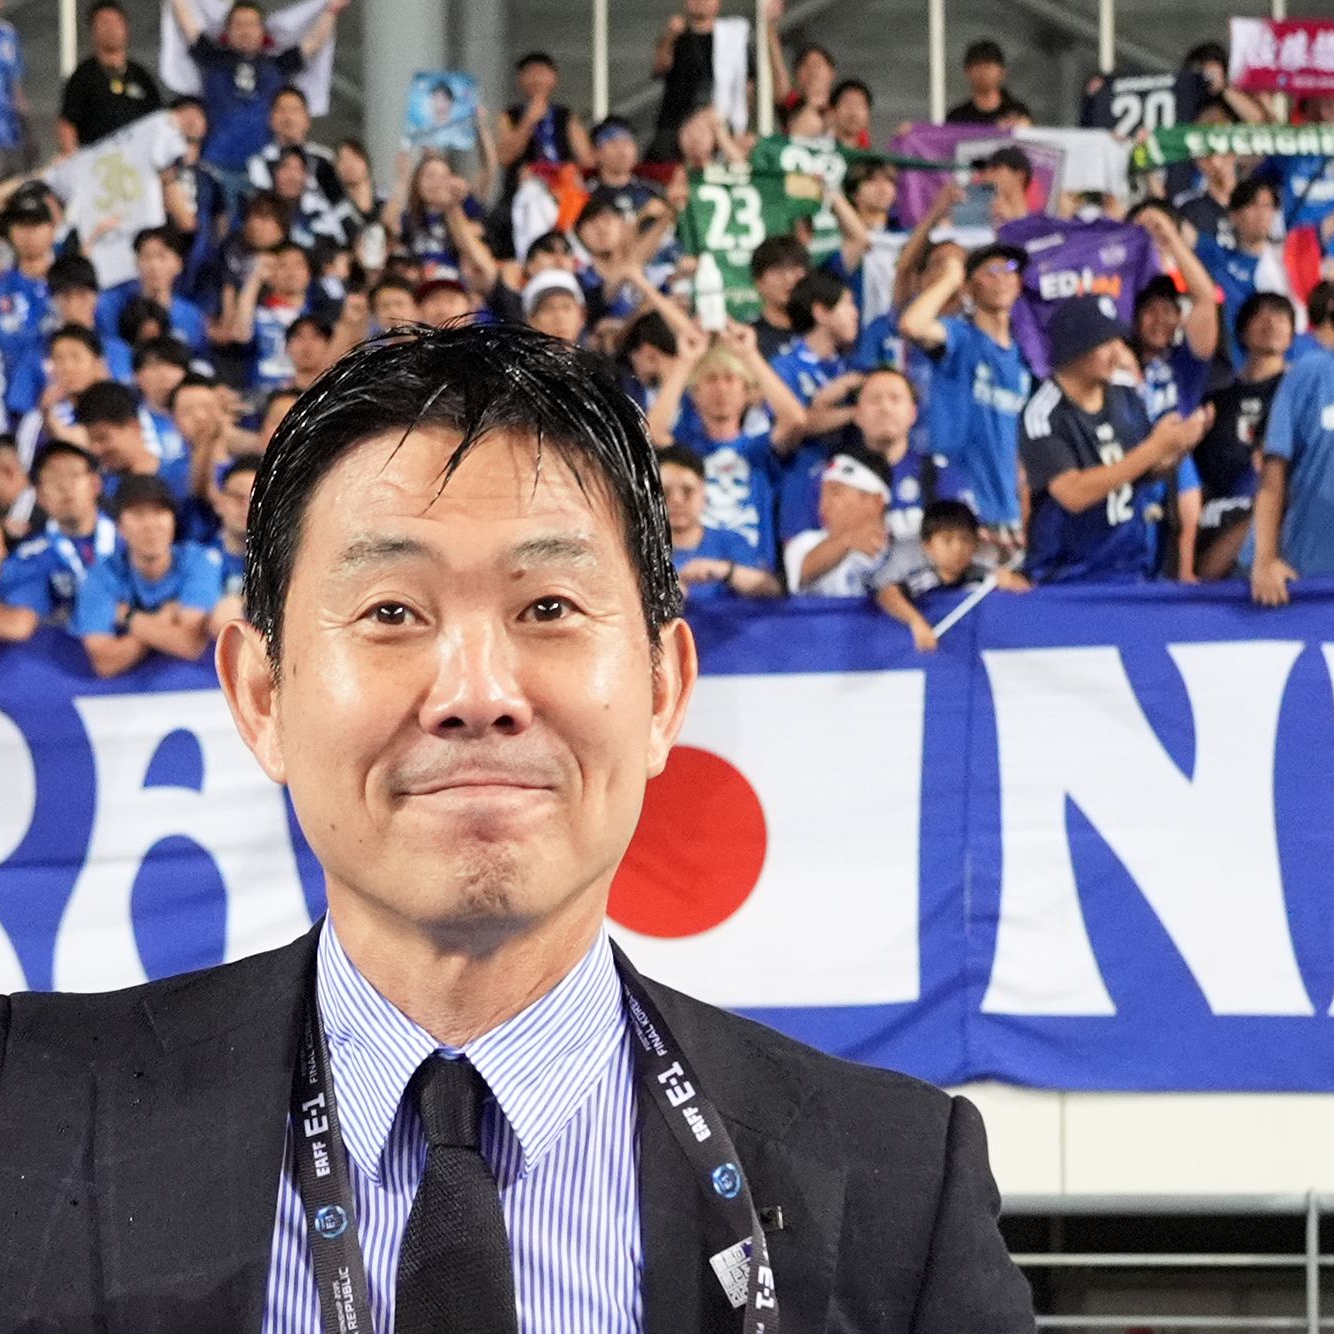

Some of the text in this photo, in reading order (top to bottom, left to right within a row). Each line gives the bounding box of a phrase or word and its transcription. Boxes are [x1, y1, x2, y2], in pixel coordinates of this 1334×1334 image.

[1111, 91, 1176, 142] 20
[698, 184, 766, 250] 23
[647, 1026, 667, 1057] FINAL
[682, 1106, 712, 1142] EAFF
[313, 1141, 331, 1177] EAFF
[338, 1266, 359, 1334] REPUBLIC
